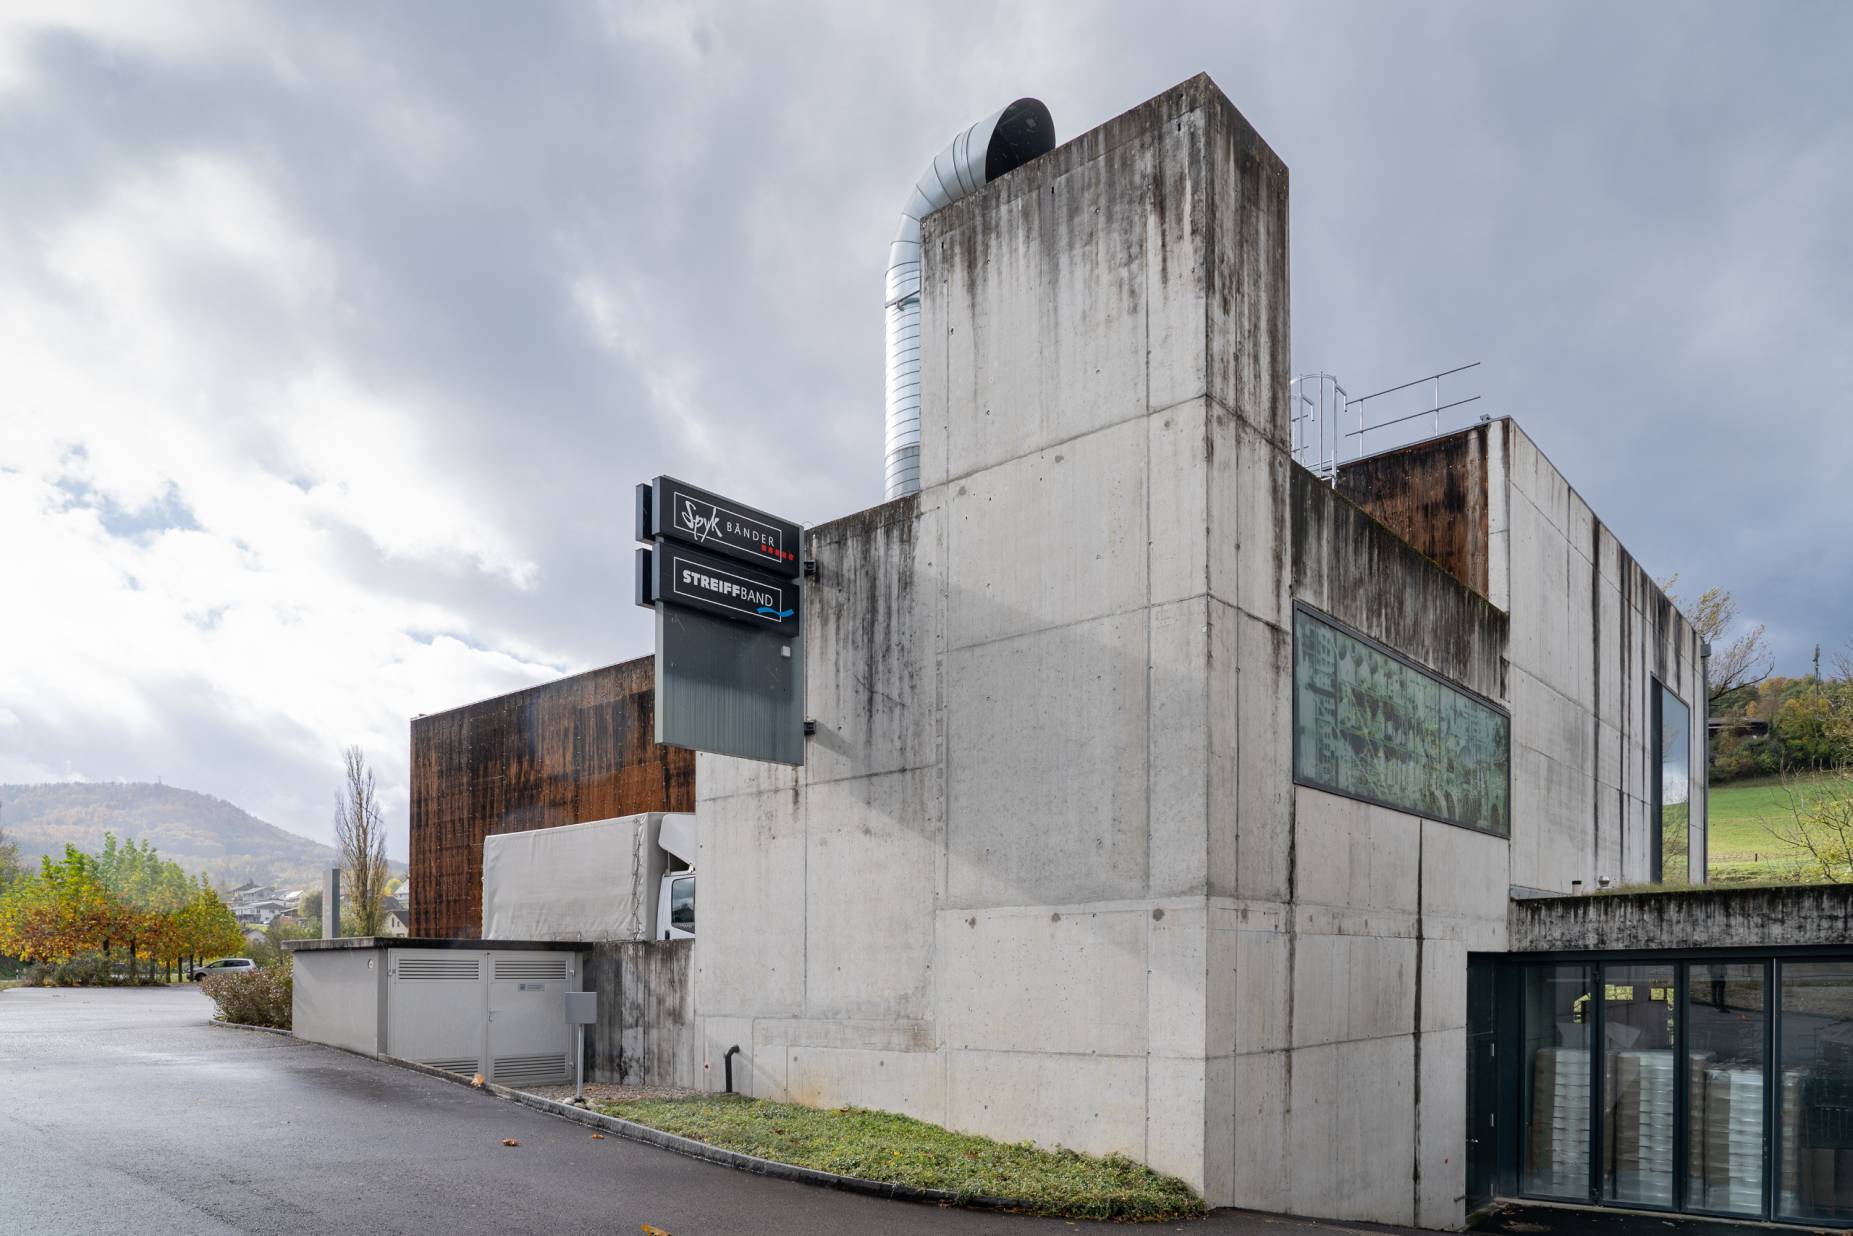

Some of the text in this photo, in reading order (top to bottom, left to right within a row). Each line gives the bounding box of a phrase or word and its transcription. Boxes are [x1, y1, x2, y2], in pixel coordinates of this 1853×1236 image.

[682, 500, 775, 547] Spyk BÄNDER
[683, 570, 774, 607] STREIFFBAND
